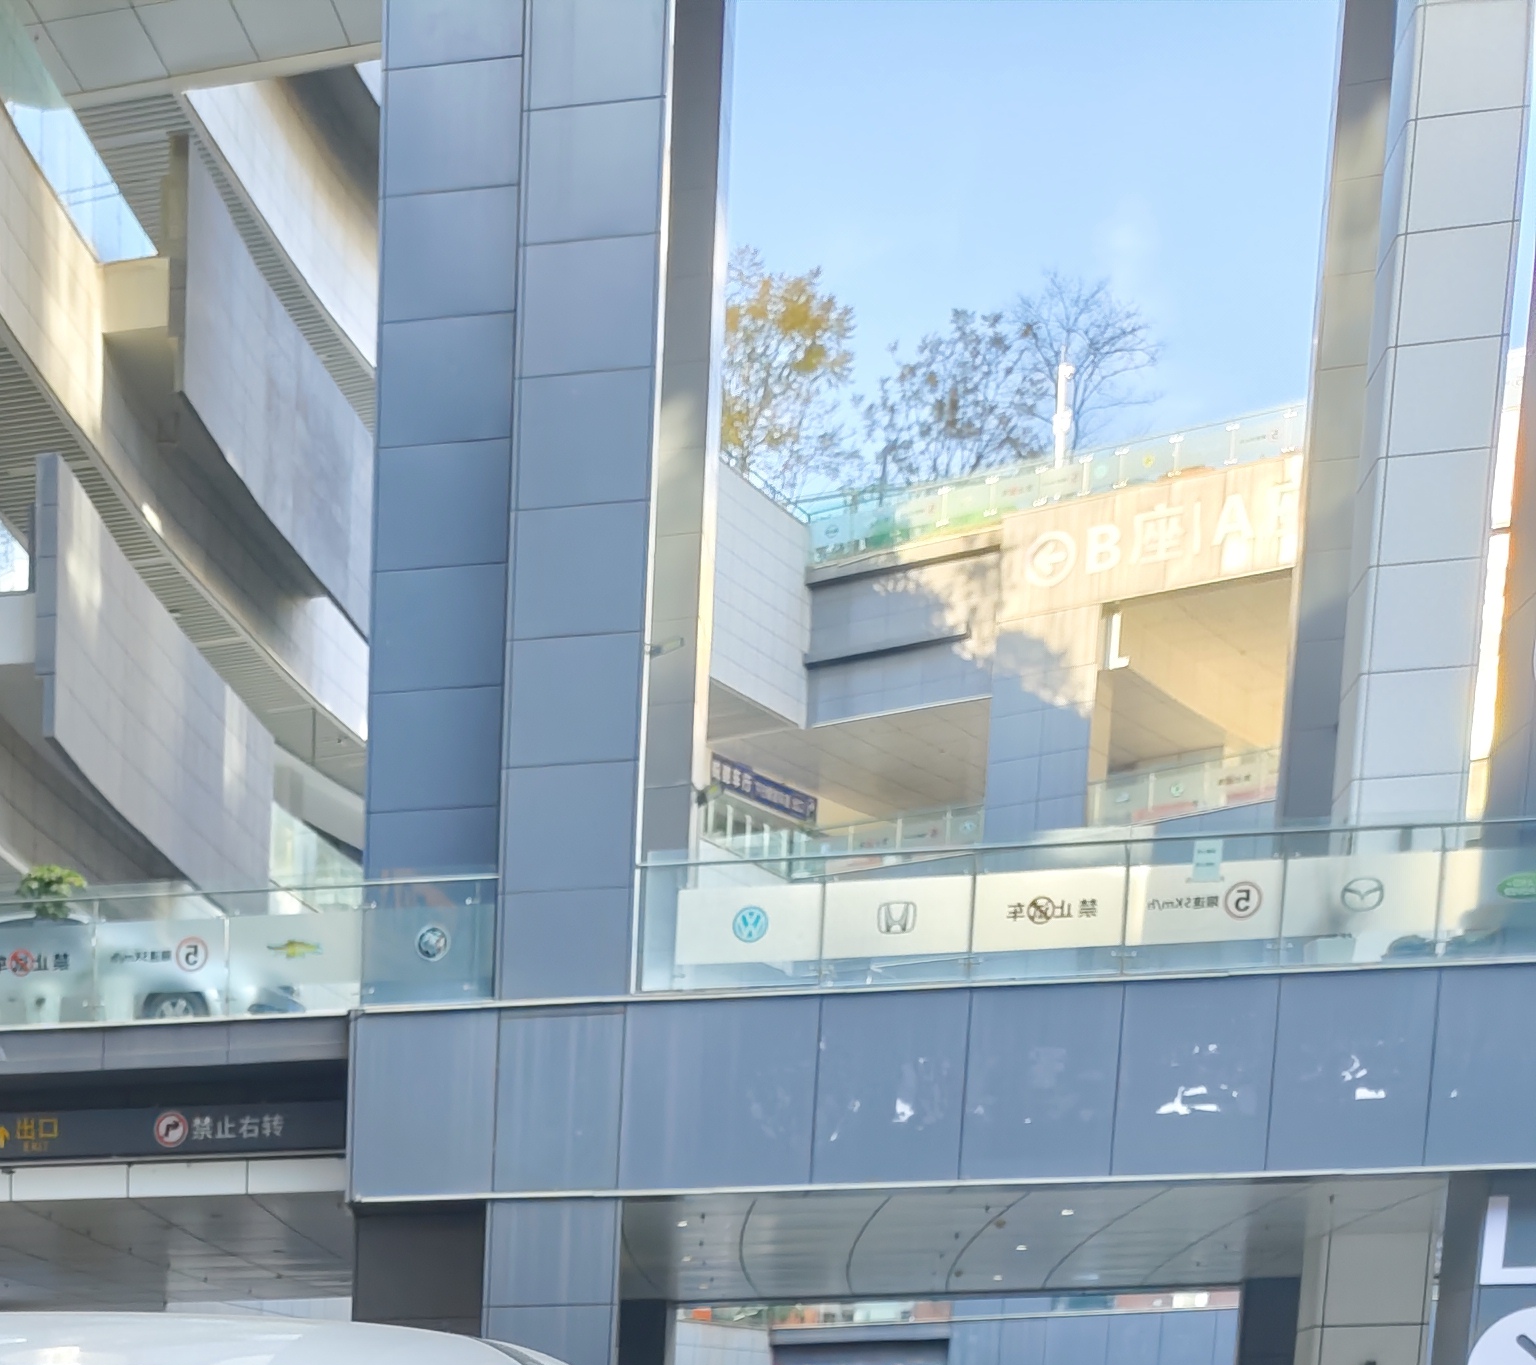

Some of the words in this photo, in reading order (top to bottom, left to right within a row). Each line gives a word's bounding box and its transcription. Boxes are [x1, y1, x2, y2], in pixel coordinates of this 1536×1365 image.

[16, 1117, 58, 1139] 出口
[192, 1114, 284, 1140] 禁止右转
